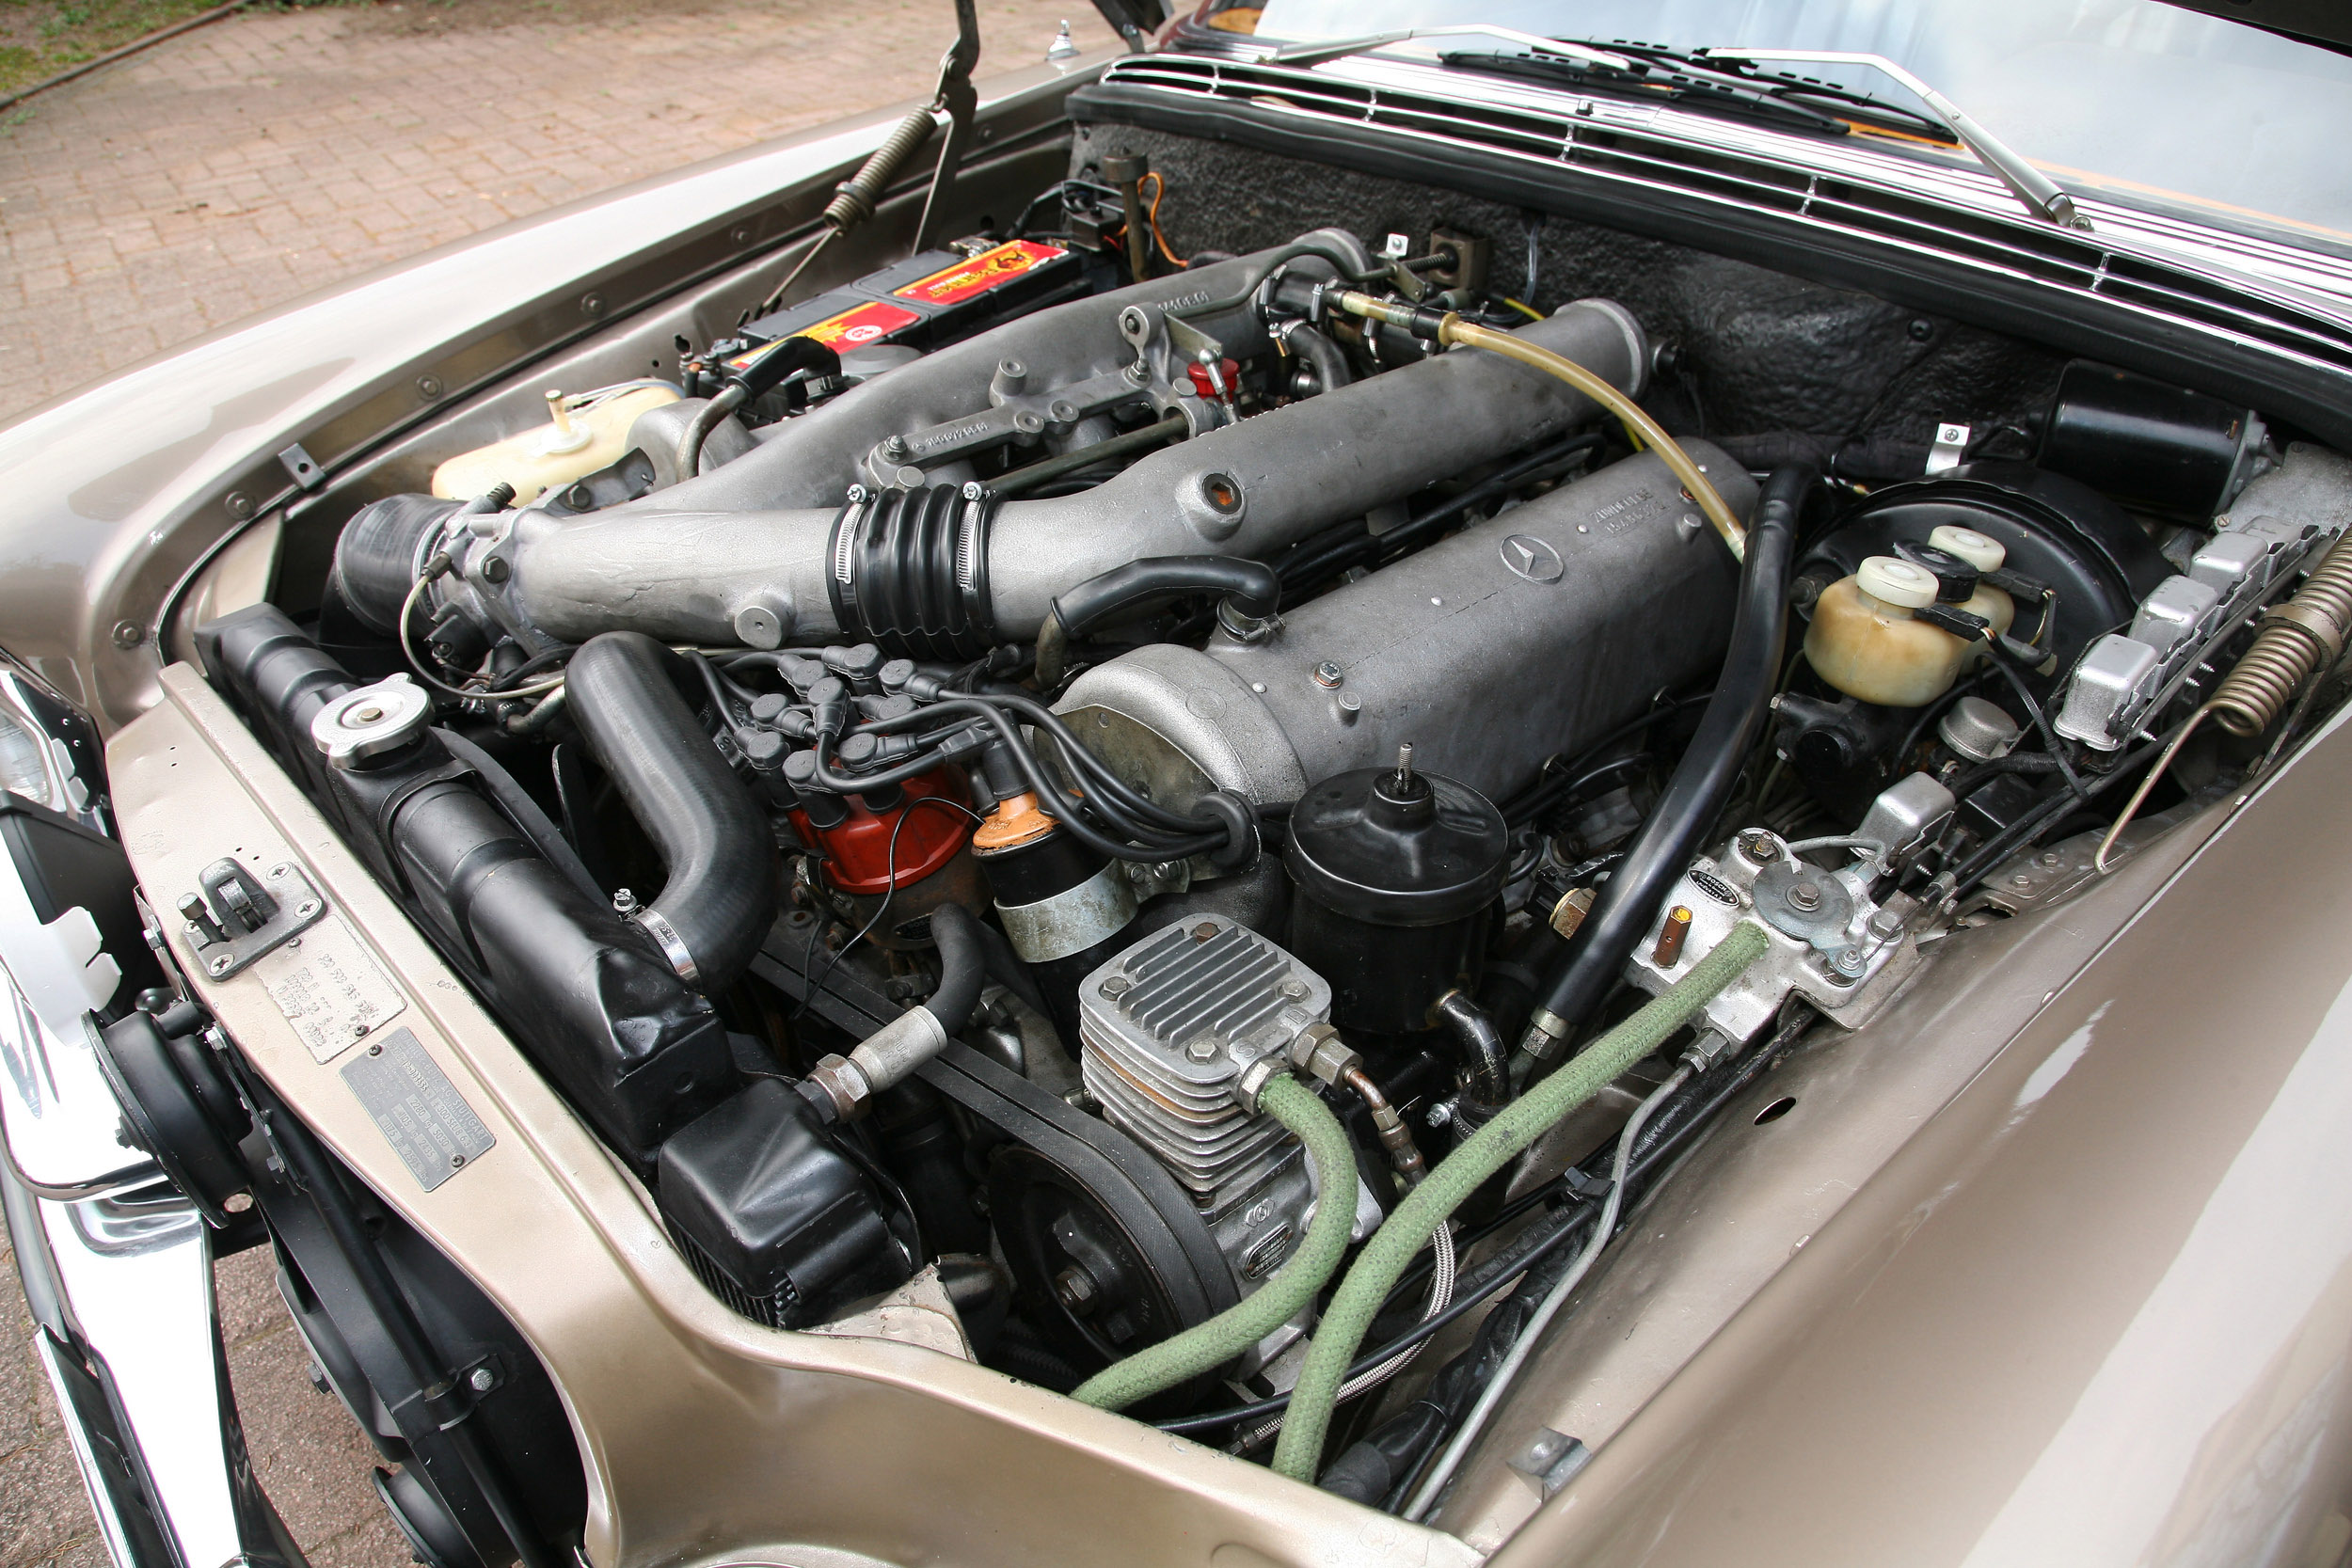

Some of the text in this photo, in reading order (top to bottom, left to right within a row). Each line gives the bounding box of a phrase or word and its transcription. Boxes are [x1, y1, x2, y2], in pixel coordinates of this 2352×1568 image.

[1706, 876, 1727, 891] BOSCH
[1236, 1044, 1256, 1059] S
[436, 1104, 451, 1120] 300
[452, 1098, 488, 1142] STUTTGART
[383, 1121, 398, 1137] 1175
[409, 1098, 426, 1117] 2280
[432, 1128, 450, 1148] 5030
